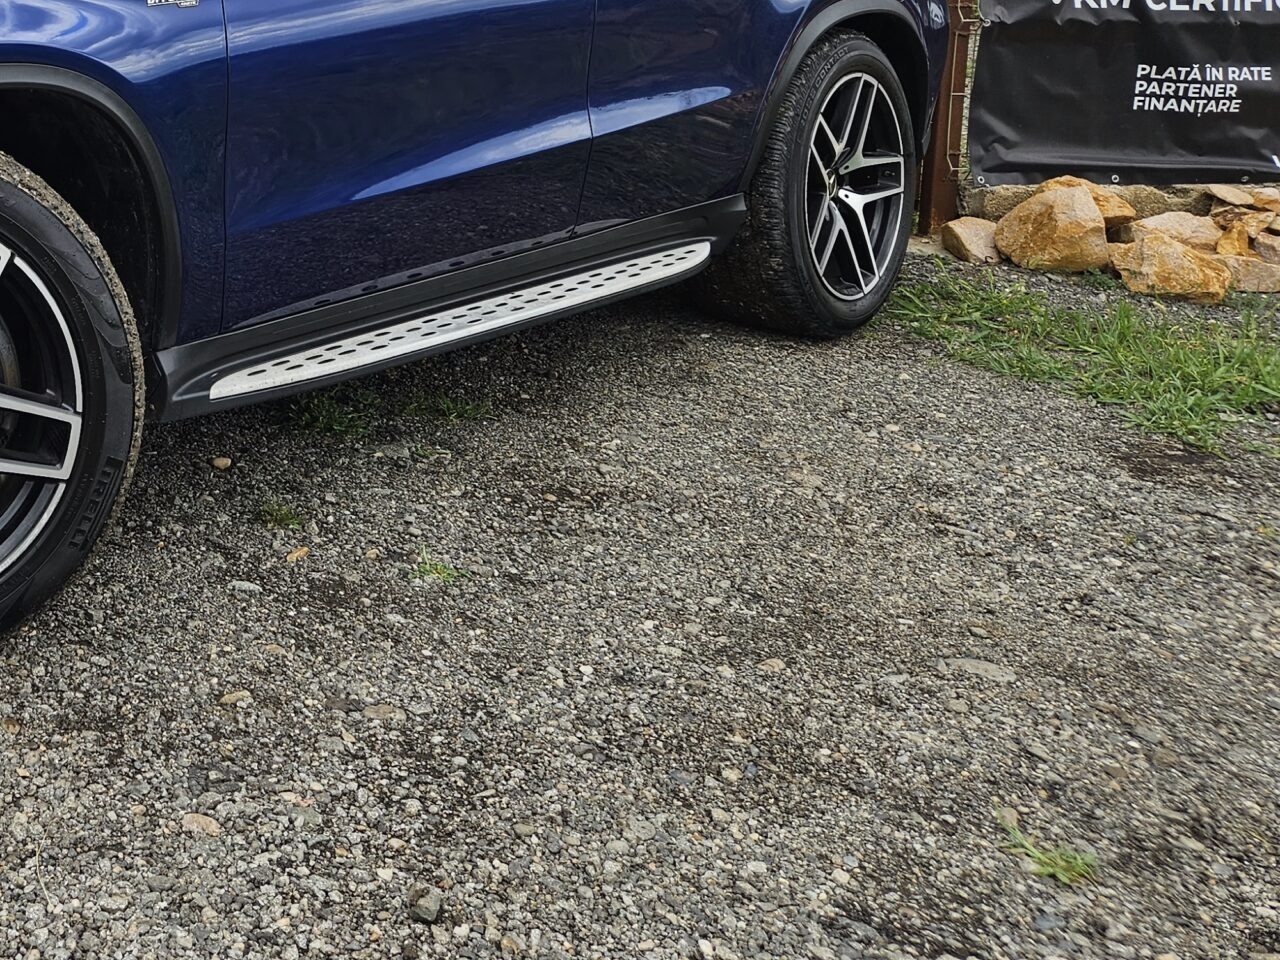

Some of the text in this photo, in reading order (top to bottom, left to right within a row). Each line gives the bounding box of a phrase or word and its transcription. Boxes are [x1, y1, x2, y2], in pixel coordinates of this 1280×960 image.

[1136, 63, 1273, 81] PLATĂ ÎN RATE
[1134, 80, 1238, 98] PARTENER
[1132, 96, 1242, 118] FINANȚARE
